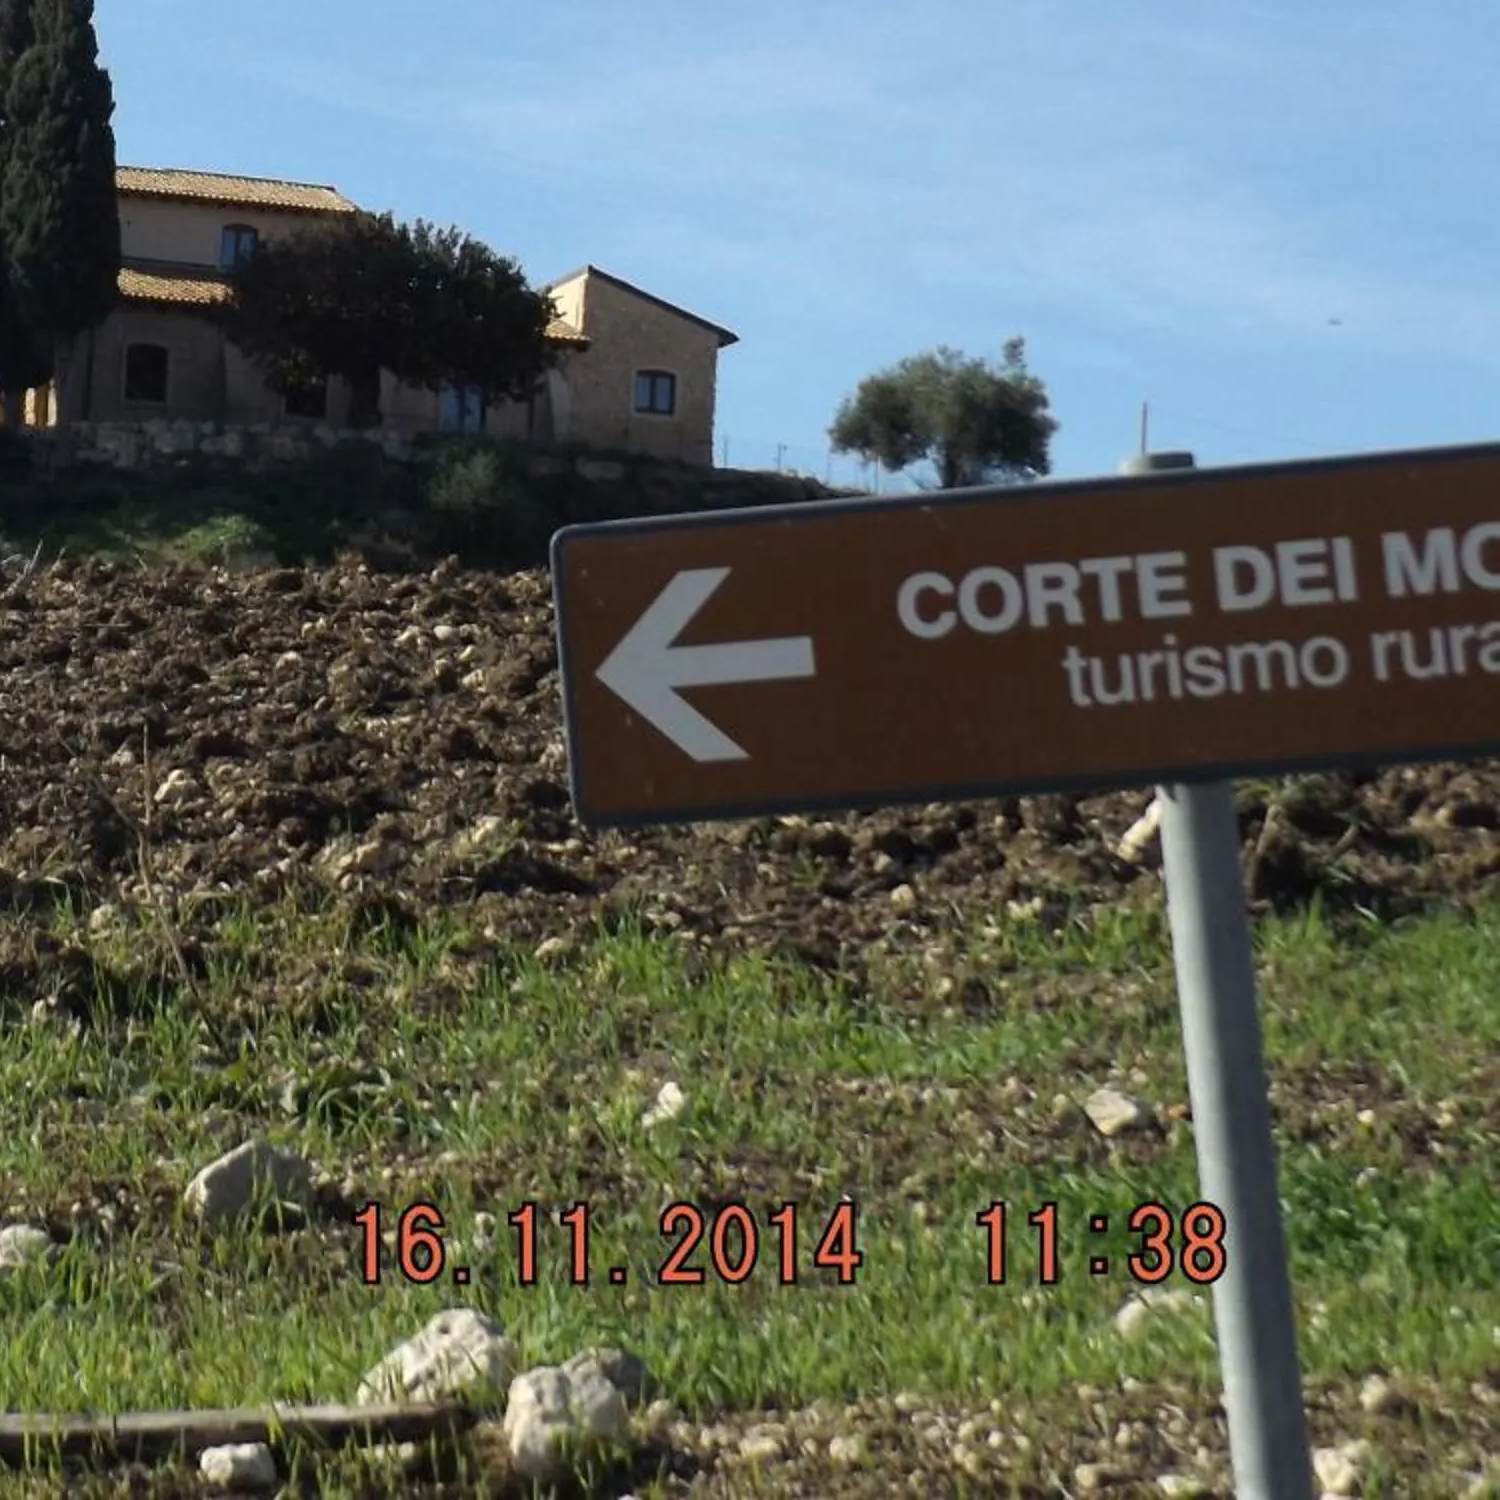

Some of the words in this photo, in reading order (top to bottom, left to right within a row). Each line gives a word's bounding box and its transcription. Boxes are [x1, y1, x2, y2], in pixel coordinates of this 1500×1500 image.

[897, 552, 1192, 639] CORTE
[1213, 537, 1358, 612] DEI
[1062, 633, 1349, 707] turismo
